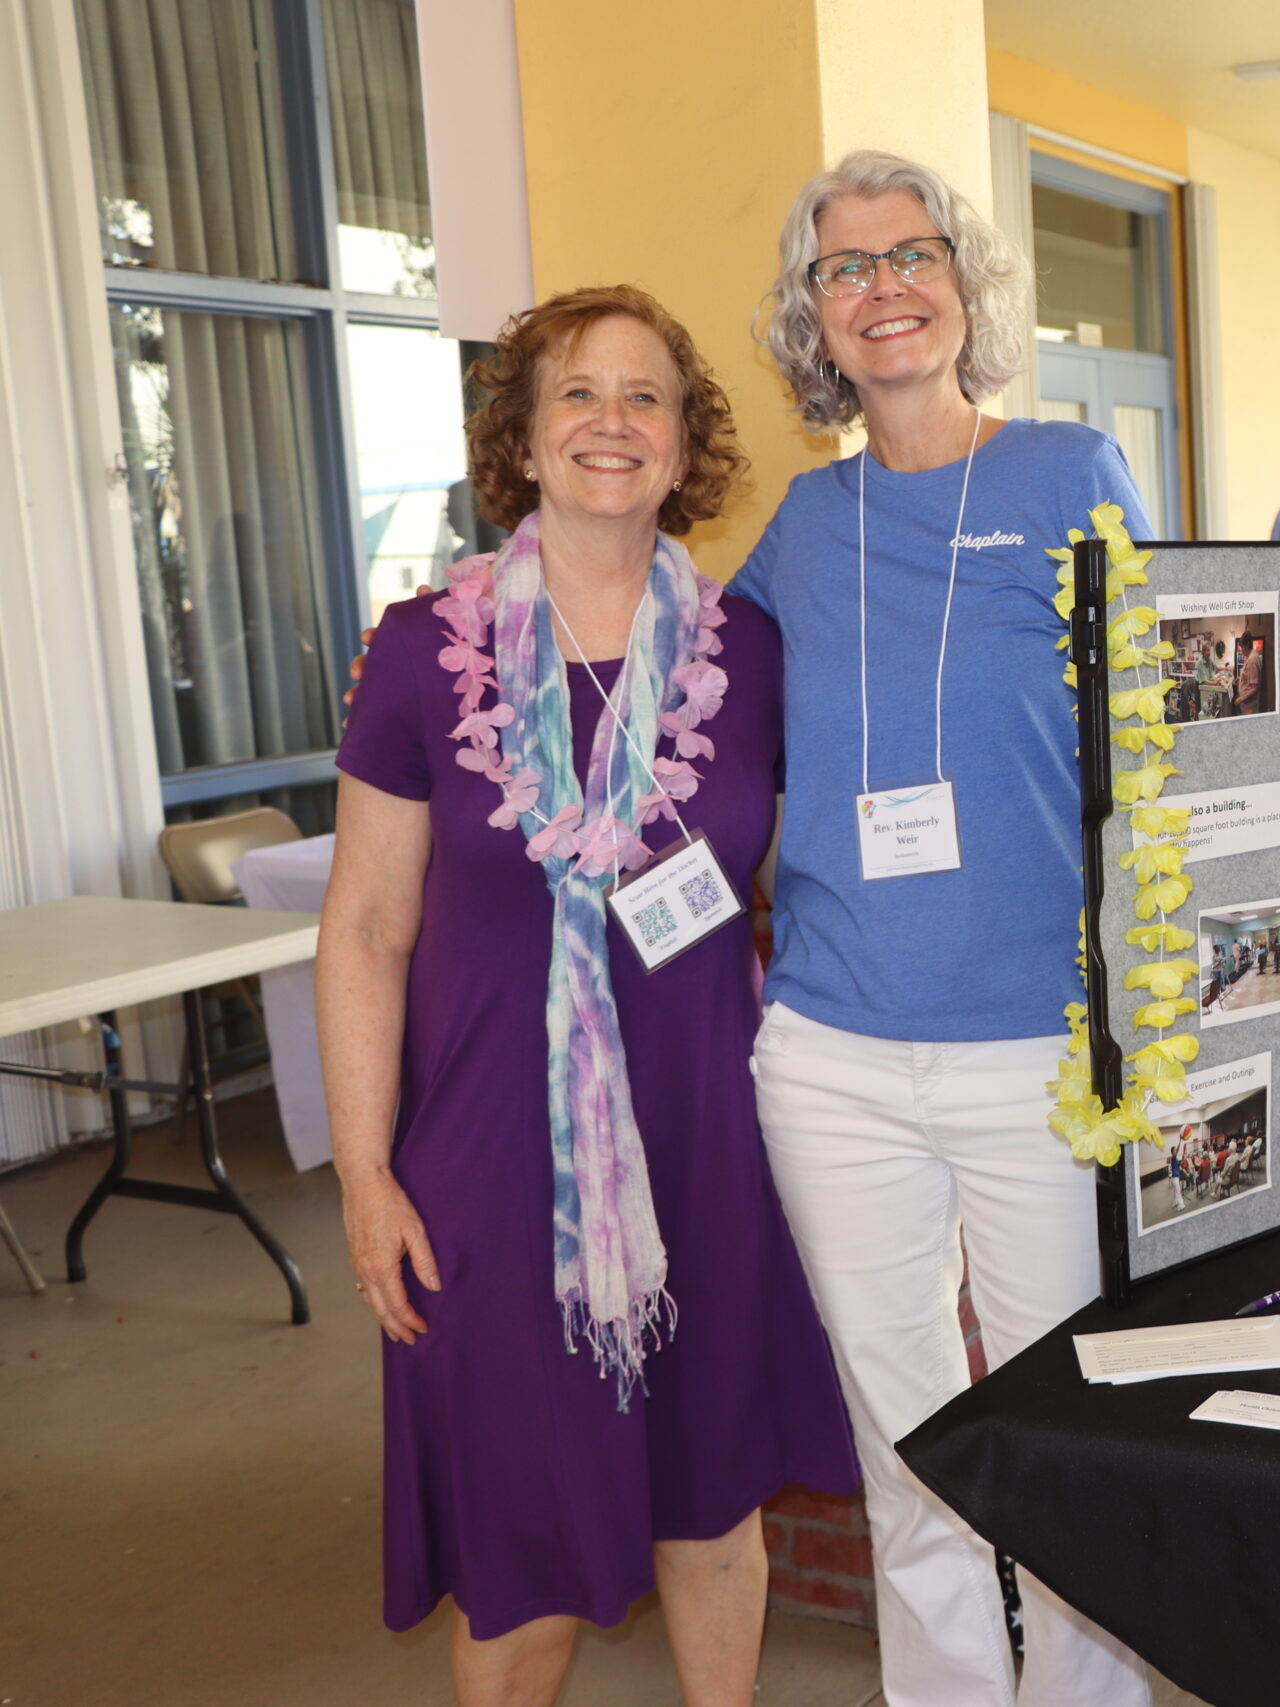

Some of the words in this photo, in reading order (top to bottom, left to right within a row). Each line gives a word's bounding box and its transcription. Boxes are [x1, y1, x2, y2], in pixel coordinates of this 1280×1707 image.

[949, 530, 1025, 552] Chaplain
[1181, 602, 1207, 613] Wishing
[1208, 601, 1224, 612] Well
[1225, 600, 1237, 610] Gift
[1238, 600, 1255, 610] Shop
[1189, 805, 1204, 817] lso
[1205, 806, 1211, 814] a
[873, 823, 894, 834] Rev.
[896, 816, 940, 831] Kimberly
[1192, 823, 1214, 836] square
[1215, 821, 1229, 831] foot
[1230, 818, 1255, 829] building
[1255, 816, 1261, 824] is
[896, 834, 919, 845] Weir
[1183, 835, 1213, 849] happens!
[1190, 1078, 1217, 1092] Exercise
[1218, 1074, 1231, 1084] and
[1231, 1067, 1256, 1080] Outings
